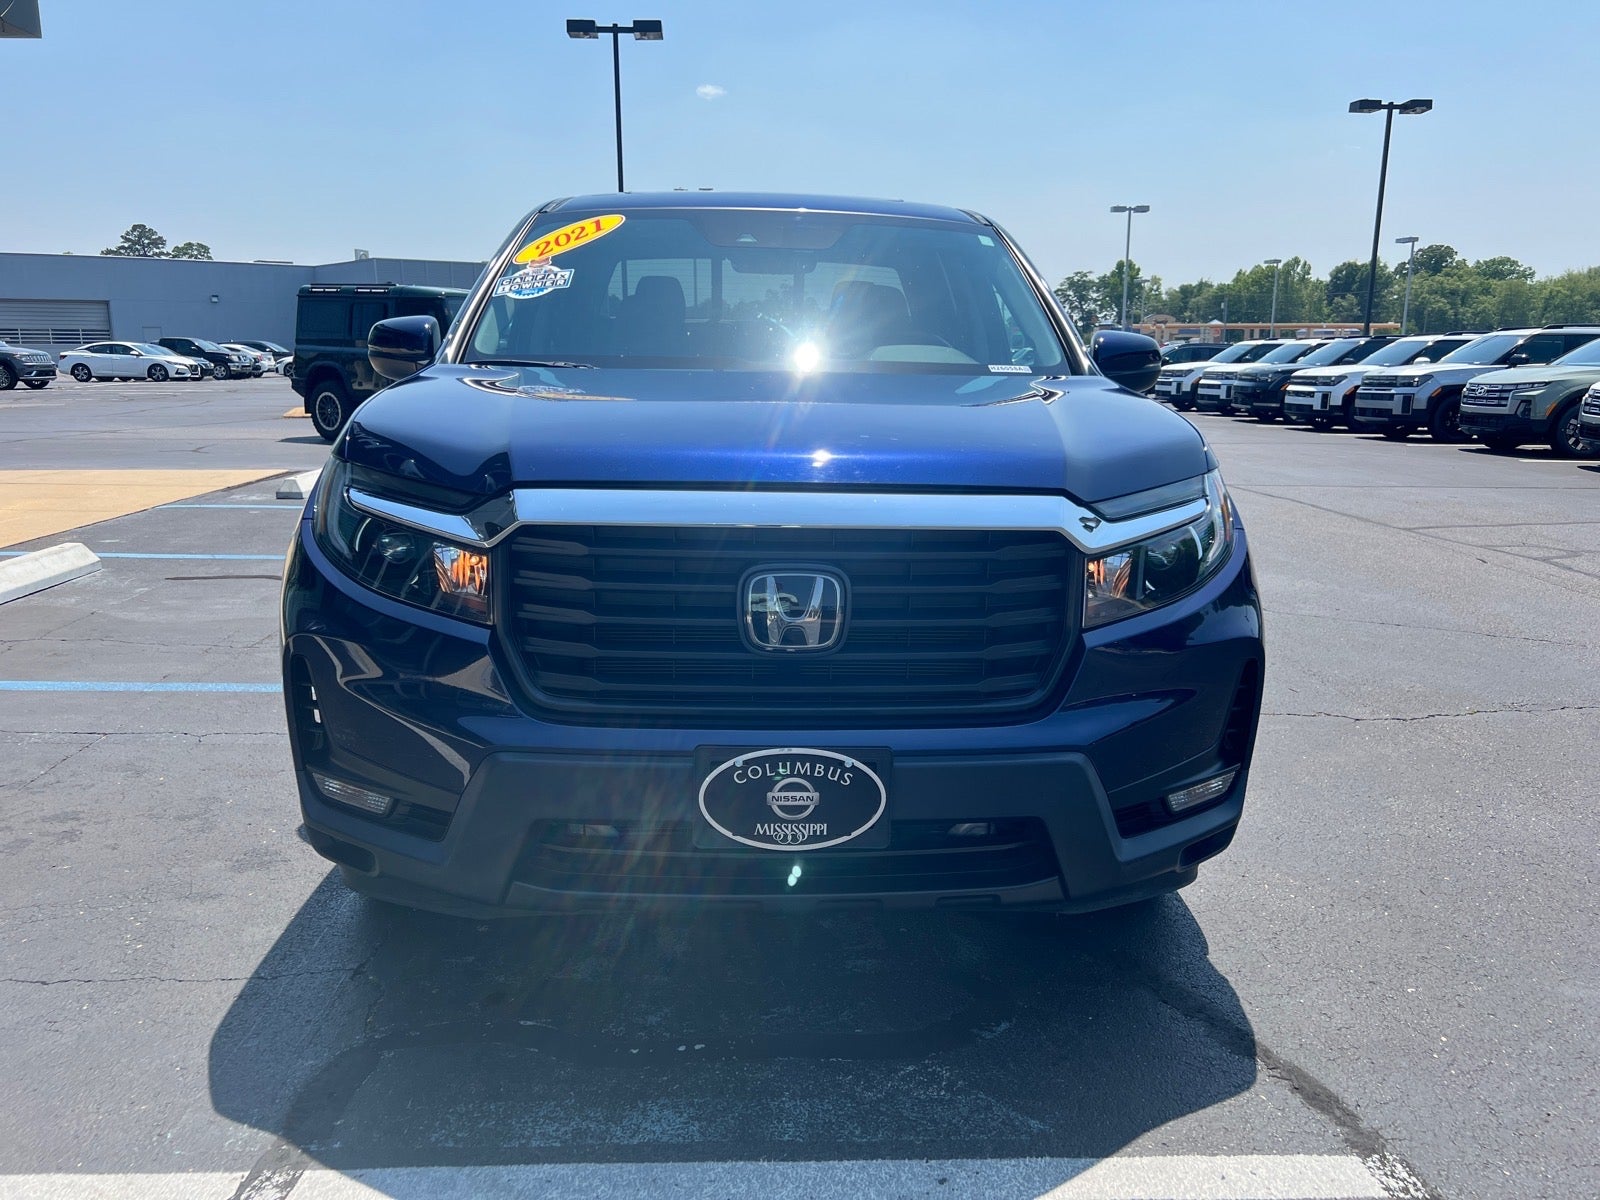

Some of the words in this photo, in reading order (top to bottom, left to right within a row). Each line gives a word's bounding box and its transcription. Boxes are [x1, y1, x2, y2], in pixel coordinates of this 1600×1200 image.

[535, 219, 605, 257] 2021
[502, 272, 569, 285] CARFAX
[733, 762, 854, 786] COLUMBUS
[771, 795, 815, 803] NISSAN
[754, 823, 828, 845] MISSISSIPPI
